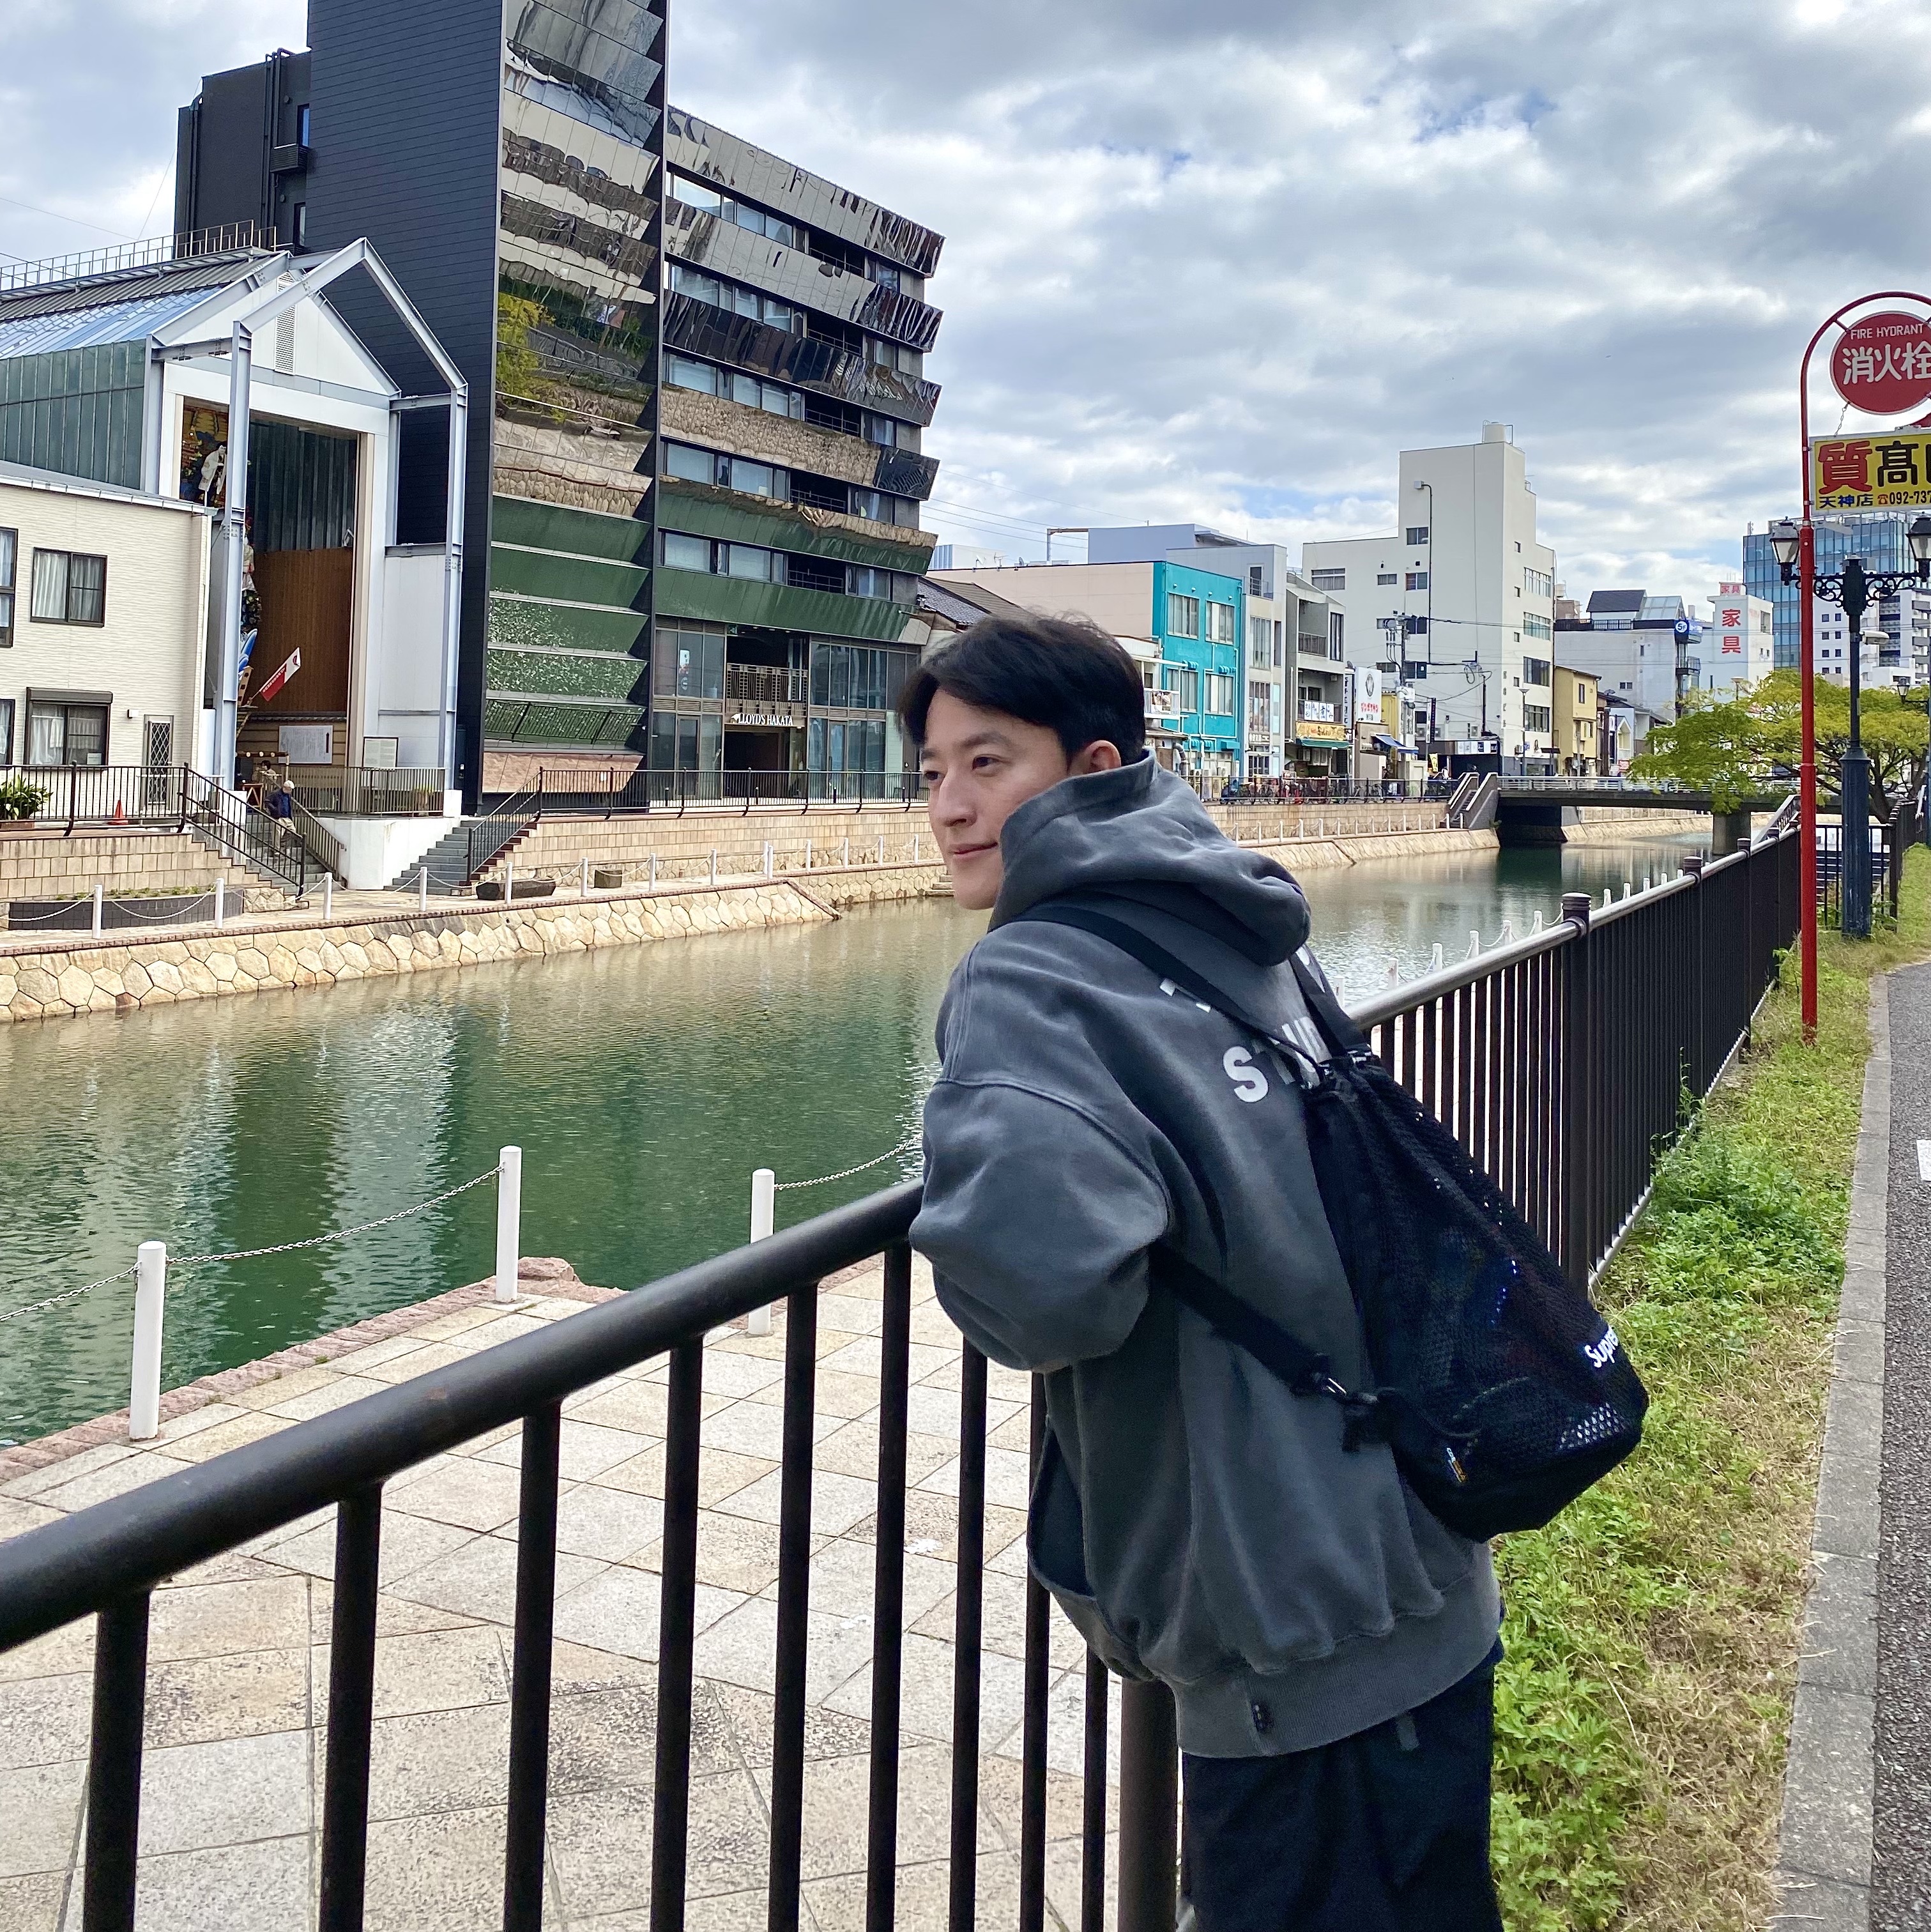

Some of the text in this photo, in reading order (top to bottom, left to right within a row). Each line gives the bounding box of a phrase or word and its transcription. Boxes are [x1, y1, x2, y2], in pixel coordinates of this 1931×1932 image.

[1850, 323, 1924, 340] FIRE HYDRANT
[1842, 341, 1931, 385] 消火栓
[1819, 494, 1874, 509] 天神店
[1721, 585, 1741, 594] 家具
[1721, 609, 1741, 654] 家具
[767, 714, 793, 726] HAKATA
